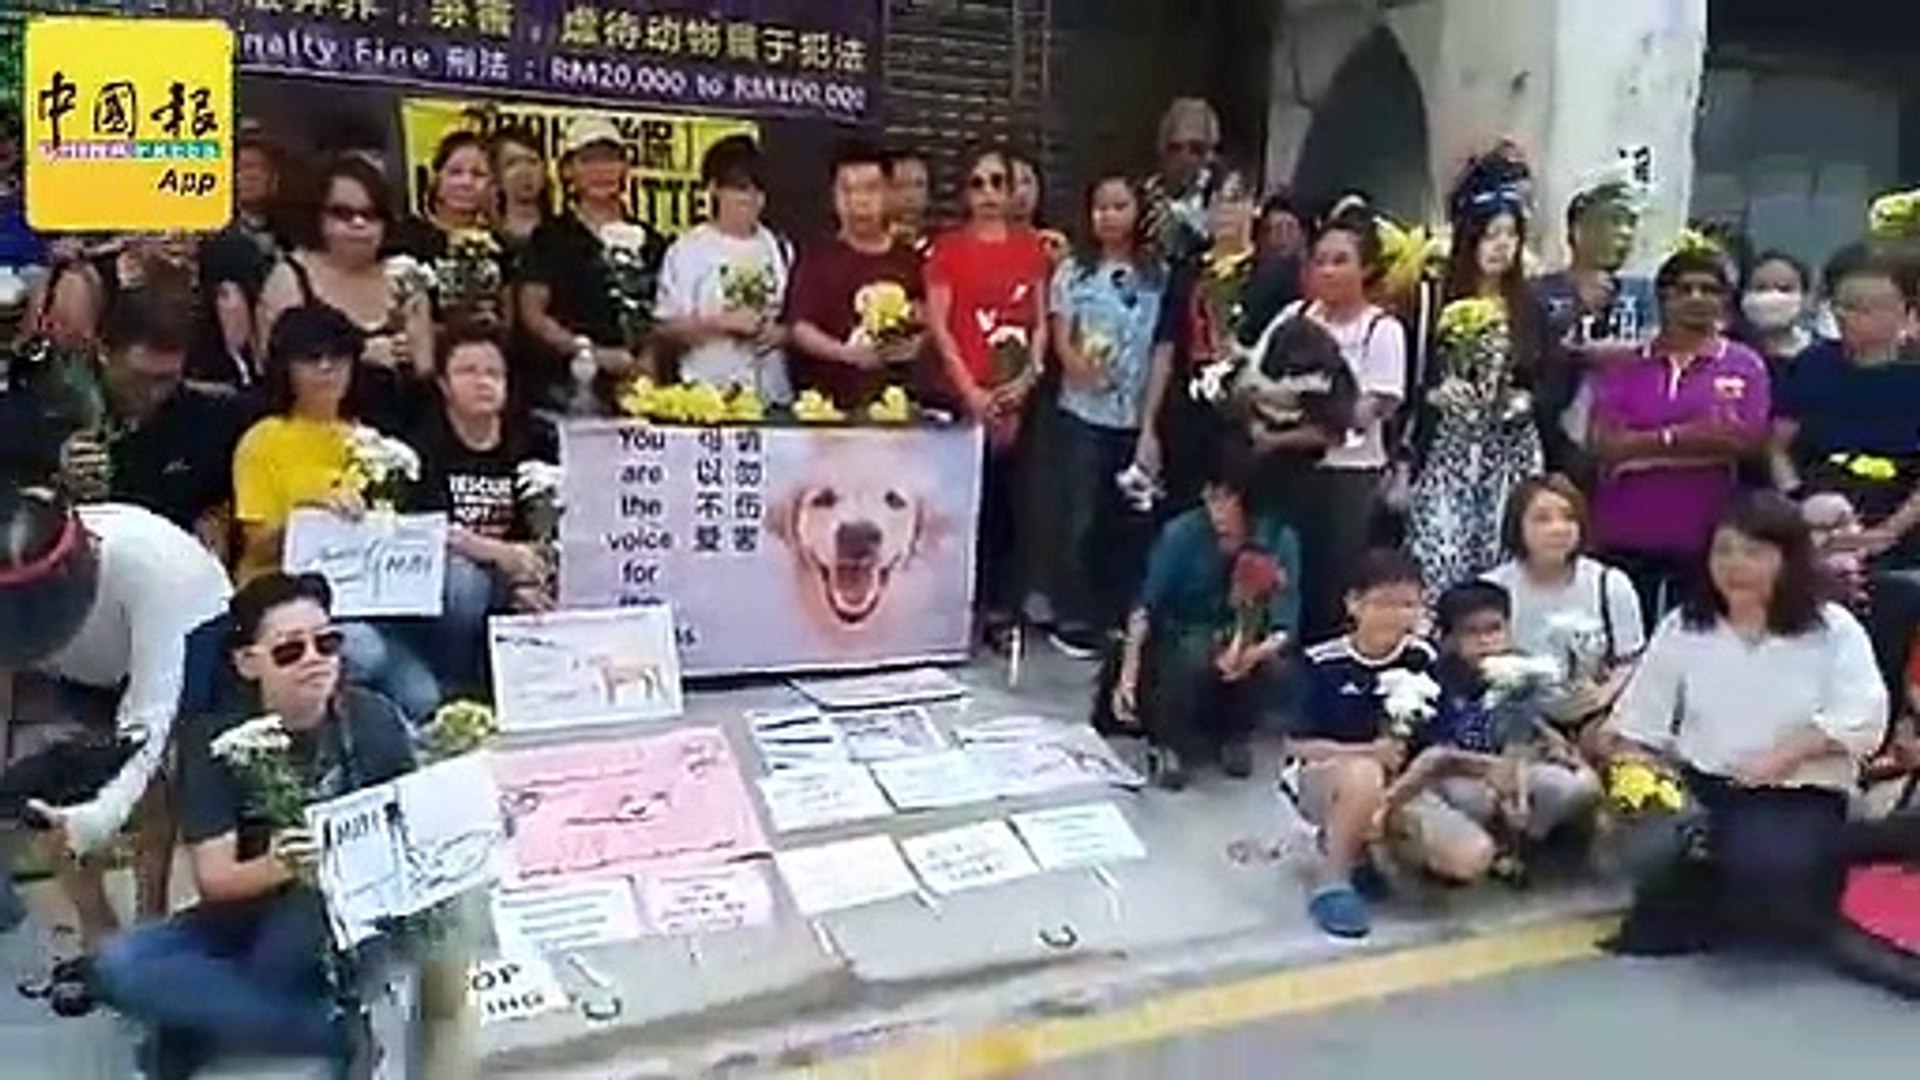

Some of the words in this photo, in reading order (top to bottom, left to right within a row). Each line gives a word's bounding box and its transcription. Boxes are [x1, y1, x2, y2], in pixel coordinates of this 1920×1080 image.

[355, 37, 429, 70] Fine
[551, 55, 685, 97] RM20,000
[696, 73, 725, 97] to
[618, 427, 666, 450] You
[621, 465, 664, 484] are
[621, 495, 663, 516] the
[607, 527, 673, 550] voice
[622, 559, 659, 583] for
